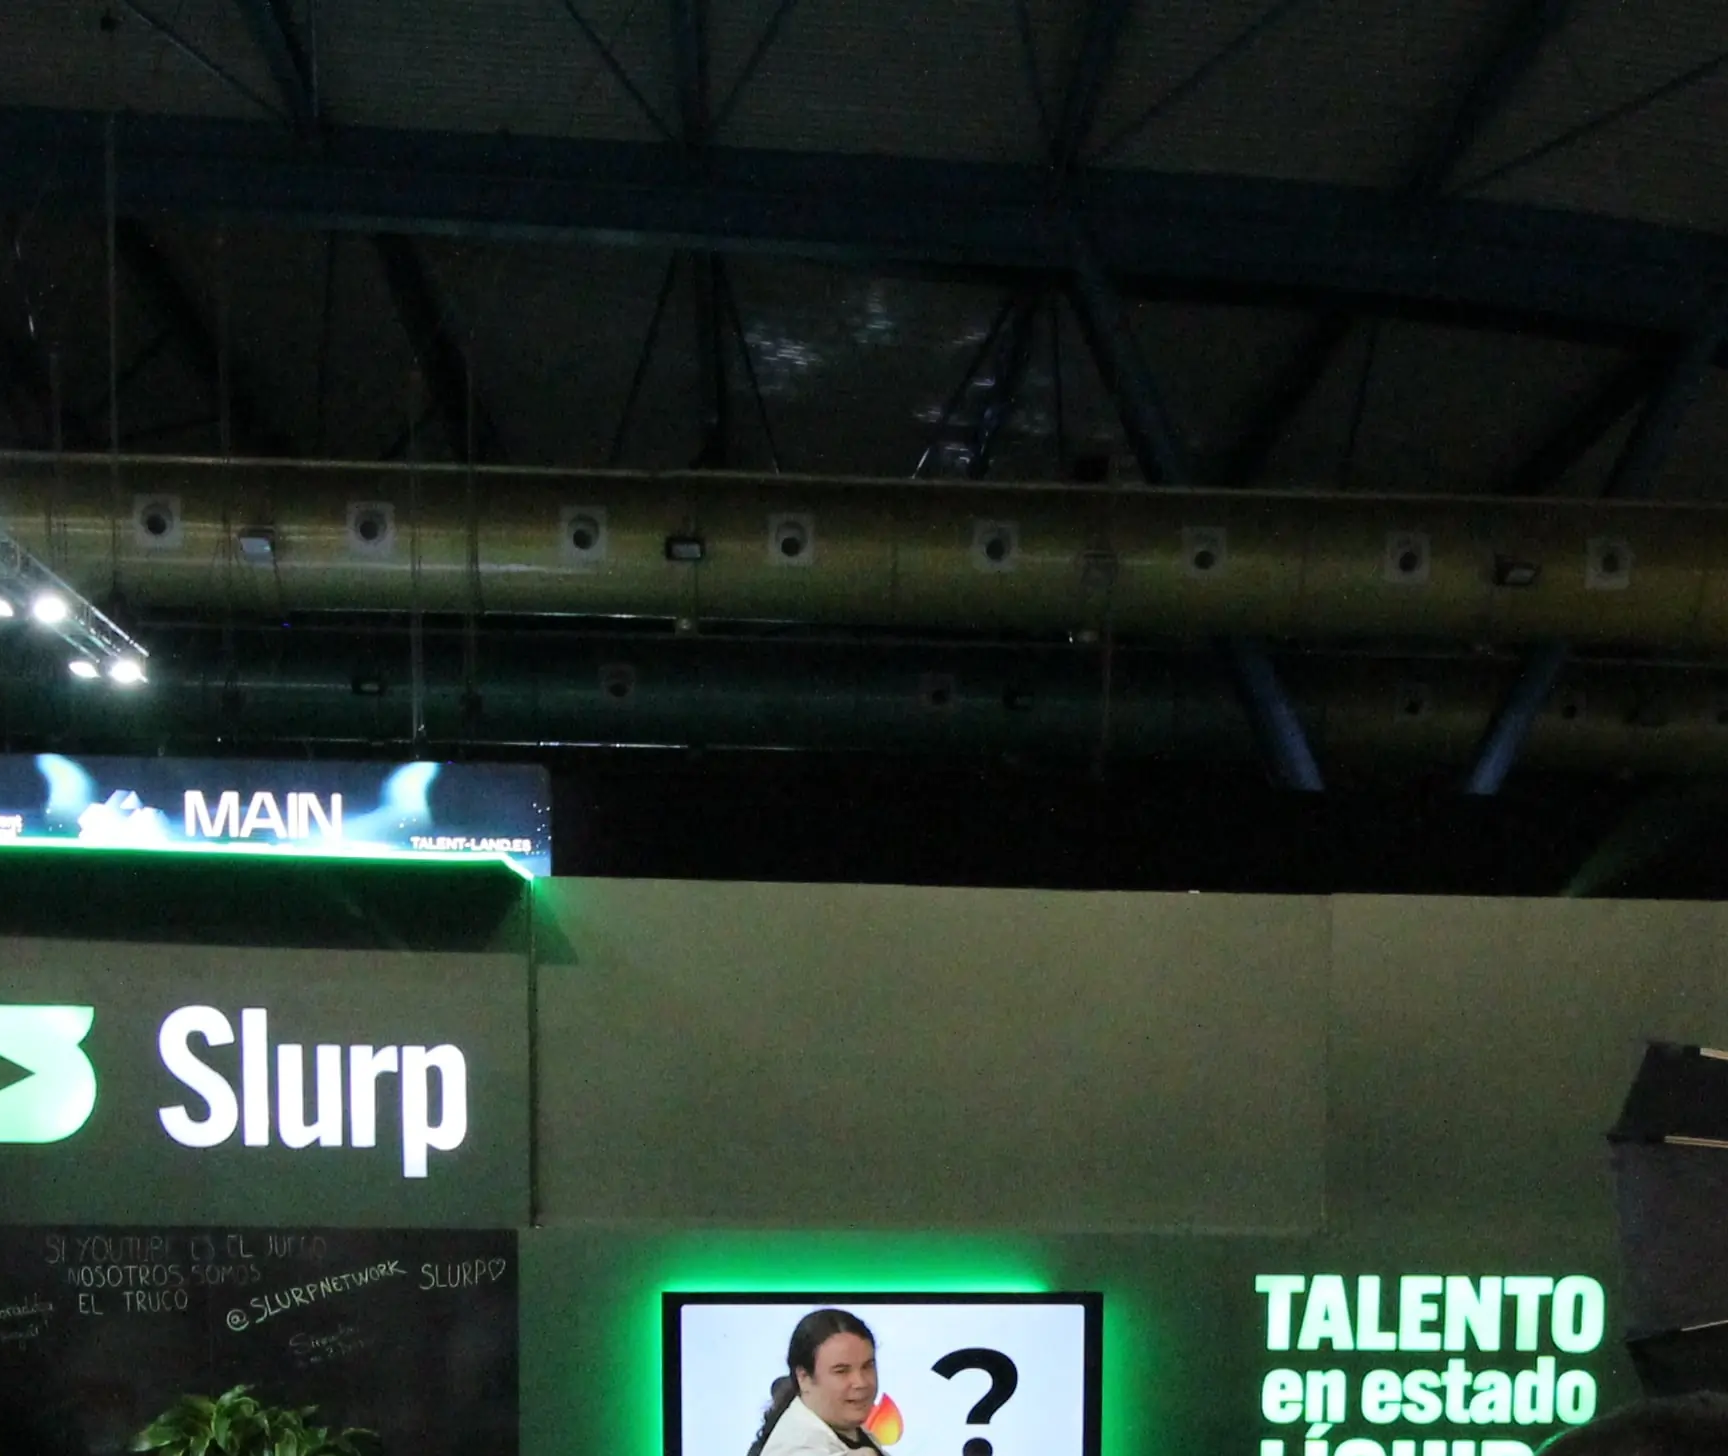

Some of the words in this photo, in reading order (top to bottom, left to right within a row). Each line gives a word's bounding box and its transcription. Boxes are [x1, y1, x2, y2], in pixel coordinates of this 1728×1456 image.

[184, 791, 343, 840] MAIN
[410, 835, 532, 853] TALENT-LAND.ES
[158, 1004, 468, 1178] Slurp
[68, 1263, 185, 1289] NOSOTROS
[191, 1262, 262, 1287] SOMOS
[418, 1260, 489, 1291] SLURP
[78, 1292, 104, 1316] EL
[123, 1288, 189, 1313] TRUCO
[1254, 1273, 1606, 1355] TALENTO
[1260, 1367, 1349, 1425] en
[1361, 1356, 1598, 1425] estado
